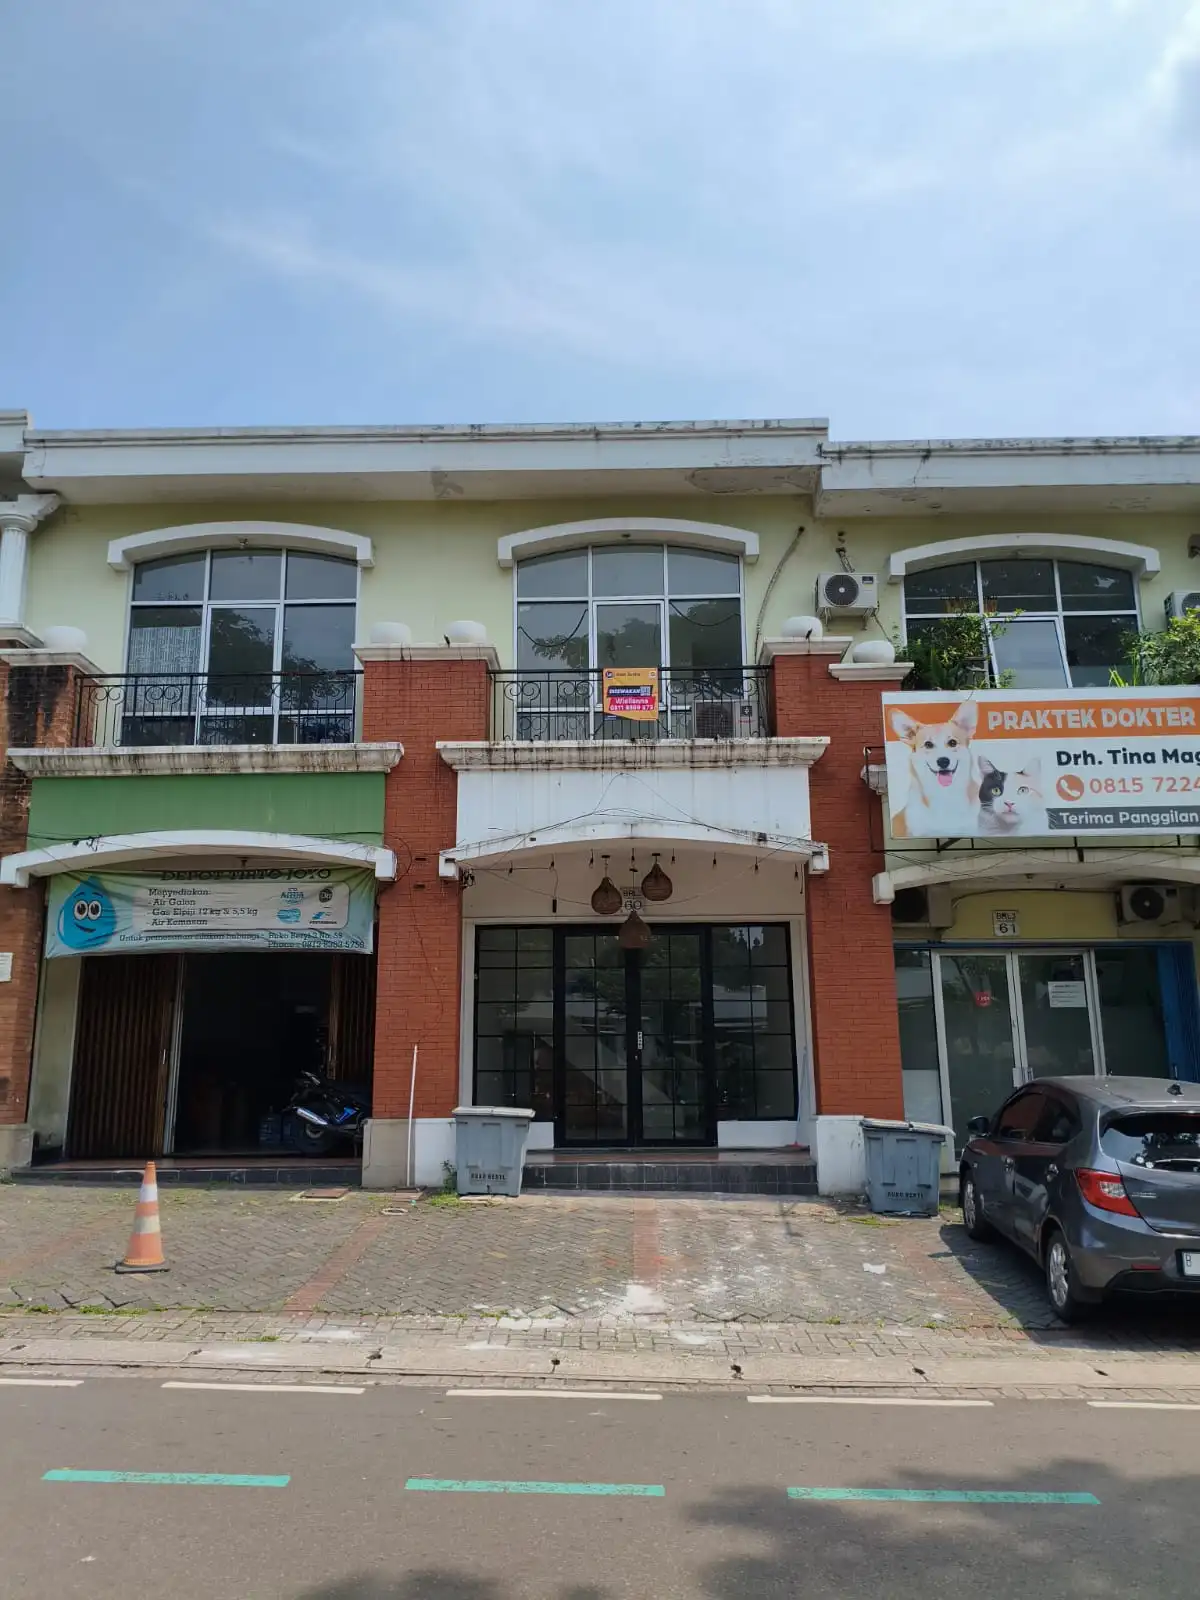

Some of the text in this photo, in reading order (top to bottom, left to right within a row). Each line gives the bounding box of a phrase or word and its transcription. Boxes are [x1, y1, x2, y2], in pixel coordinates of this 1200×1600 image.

[987, 706, 1195, 731] PRAKTEK DOKTER
[1056, 749, 1103, 767] Drh.
[1107, 747, 1156, 765] Tina
[1089, 777, 1144, 794] 0815
[1059, 810, 1199, 827] Terima Panggilan
[152, 898, 196, 906] Air Galon
[152, 908, 170, 916] Gas
[247, 907, 258, 916] kg
[151, 918, 167, 926] Air
[999, 922, 1016, 934] 61
